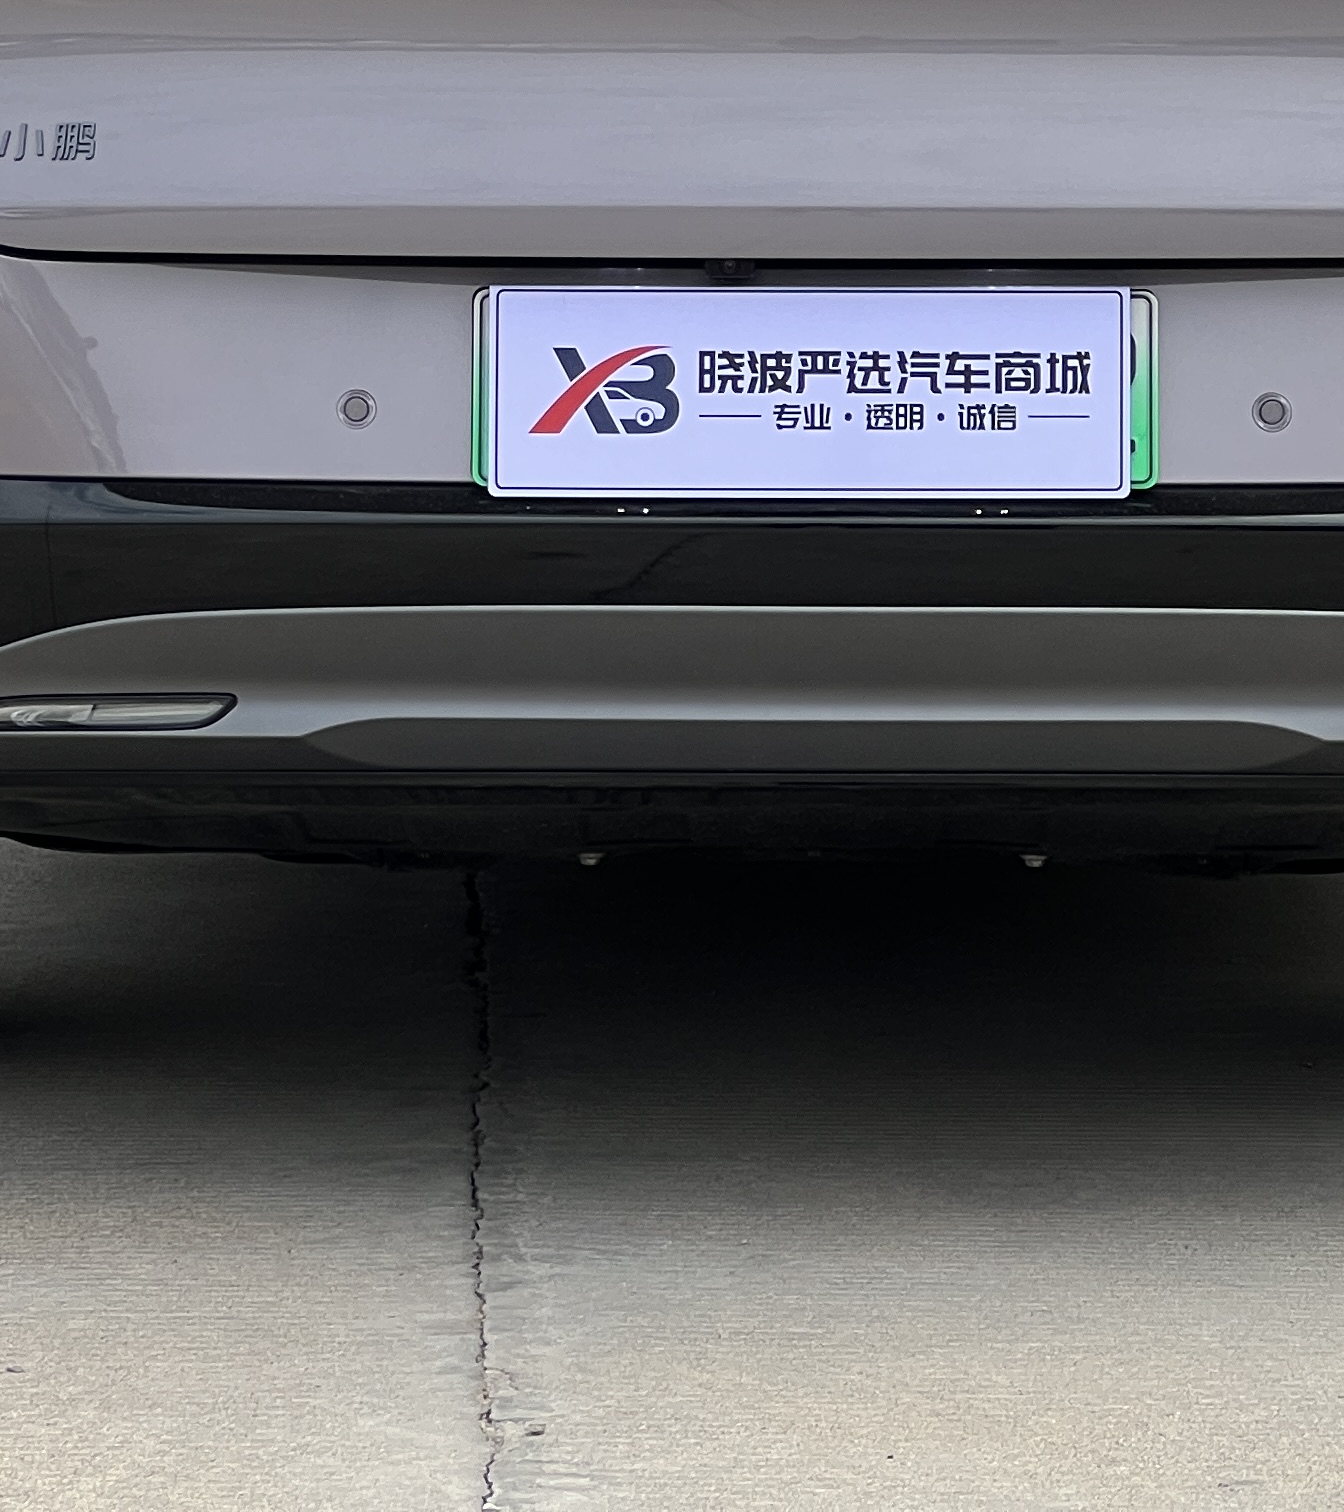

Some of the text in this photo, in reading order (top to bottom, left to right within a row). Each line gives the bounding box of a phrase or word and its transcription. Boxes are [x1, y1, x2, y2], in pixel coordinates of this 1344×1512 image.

[697, 350, 1092, 396] 晓波严选汽车商城
